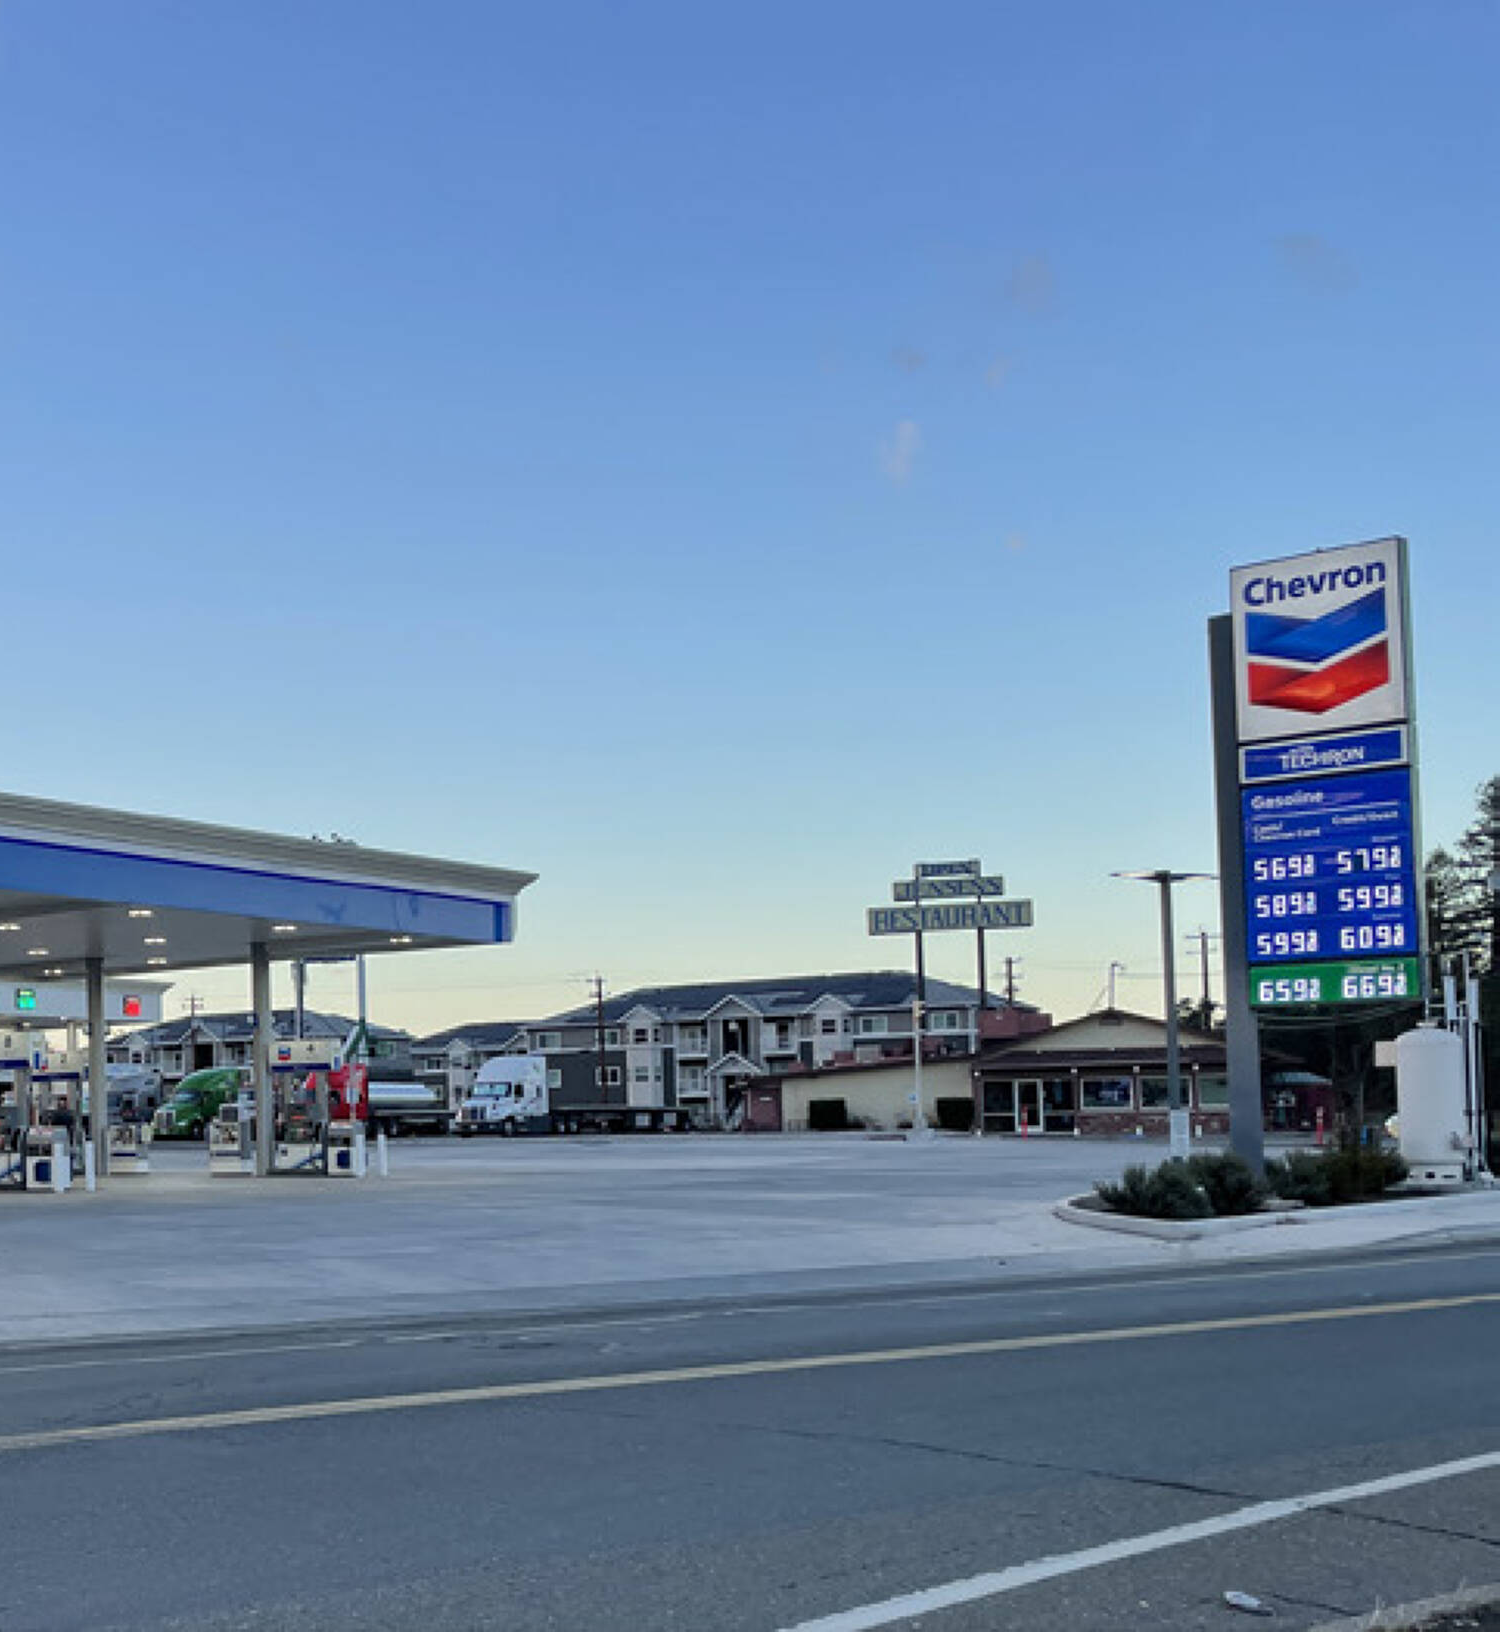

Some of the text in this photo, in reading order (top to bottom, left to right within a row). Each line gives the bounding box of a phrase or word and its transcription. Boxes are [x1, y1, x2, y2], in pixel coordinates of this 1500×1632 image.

[1244, 562, 1386, 606] Chevron
[1251, 790, 1324, 809] Gasoline
[874, 903, 1026, 932] RESTAURANT
